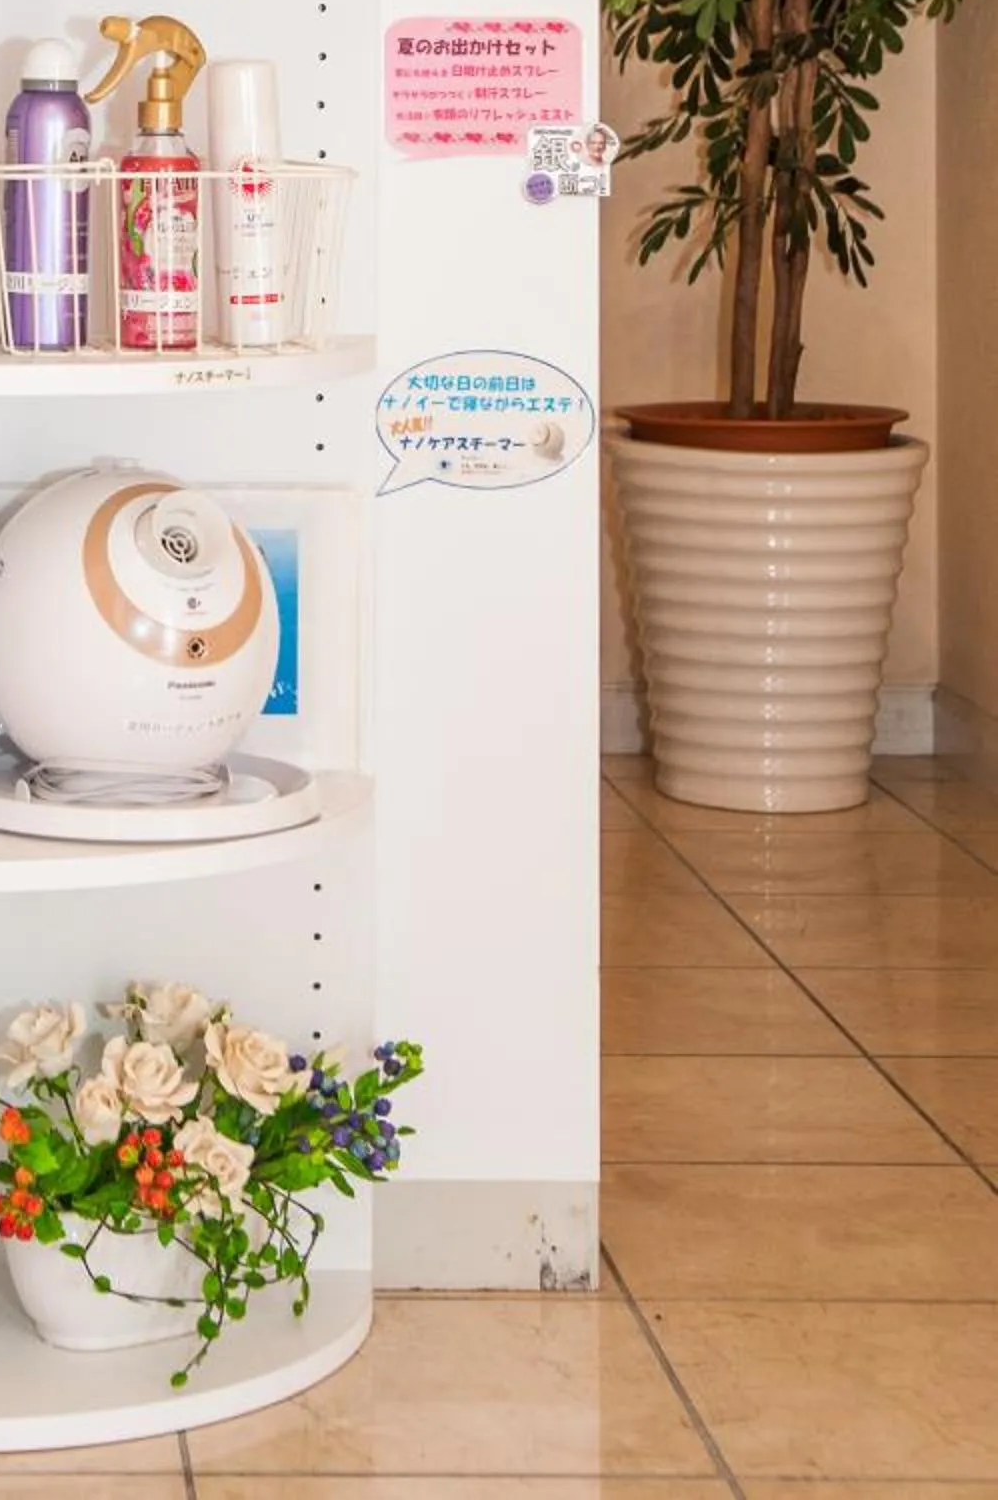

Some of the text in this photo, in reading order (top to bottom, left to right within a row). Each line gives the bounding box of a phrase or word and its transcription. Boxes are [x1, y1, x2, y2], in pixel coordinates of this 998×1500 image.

[396, 36, 556, 56] 夏のお出かけセット
[407, 374, 536, 392] 大切な日の前日は
[400, 436, 526, 451] ナノケアスチーマー
